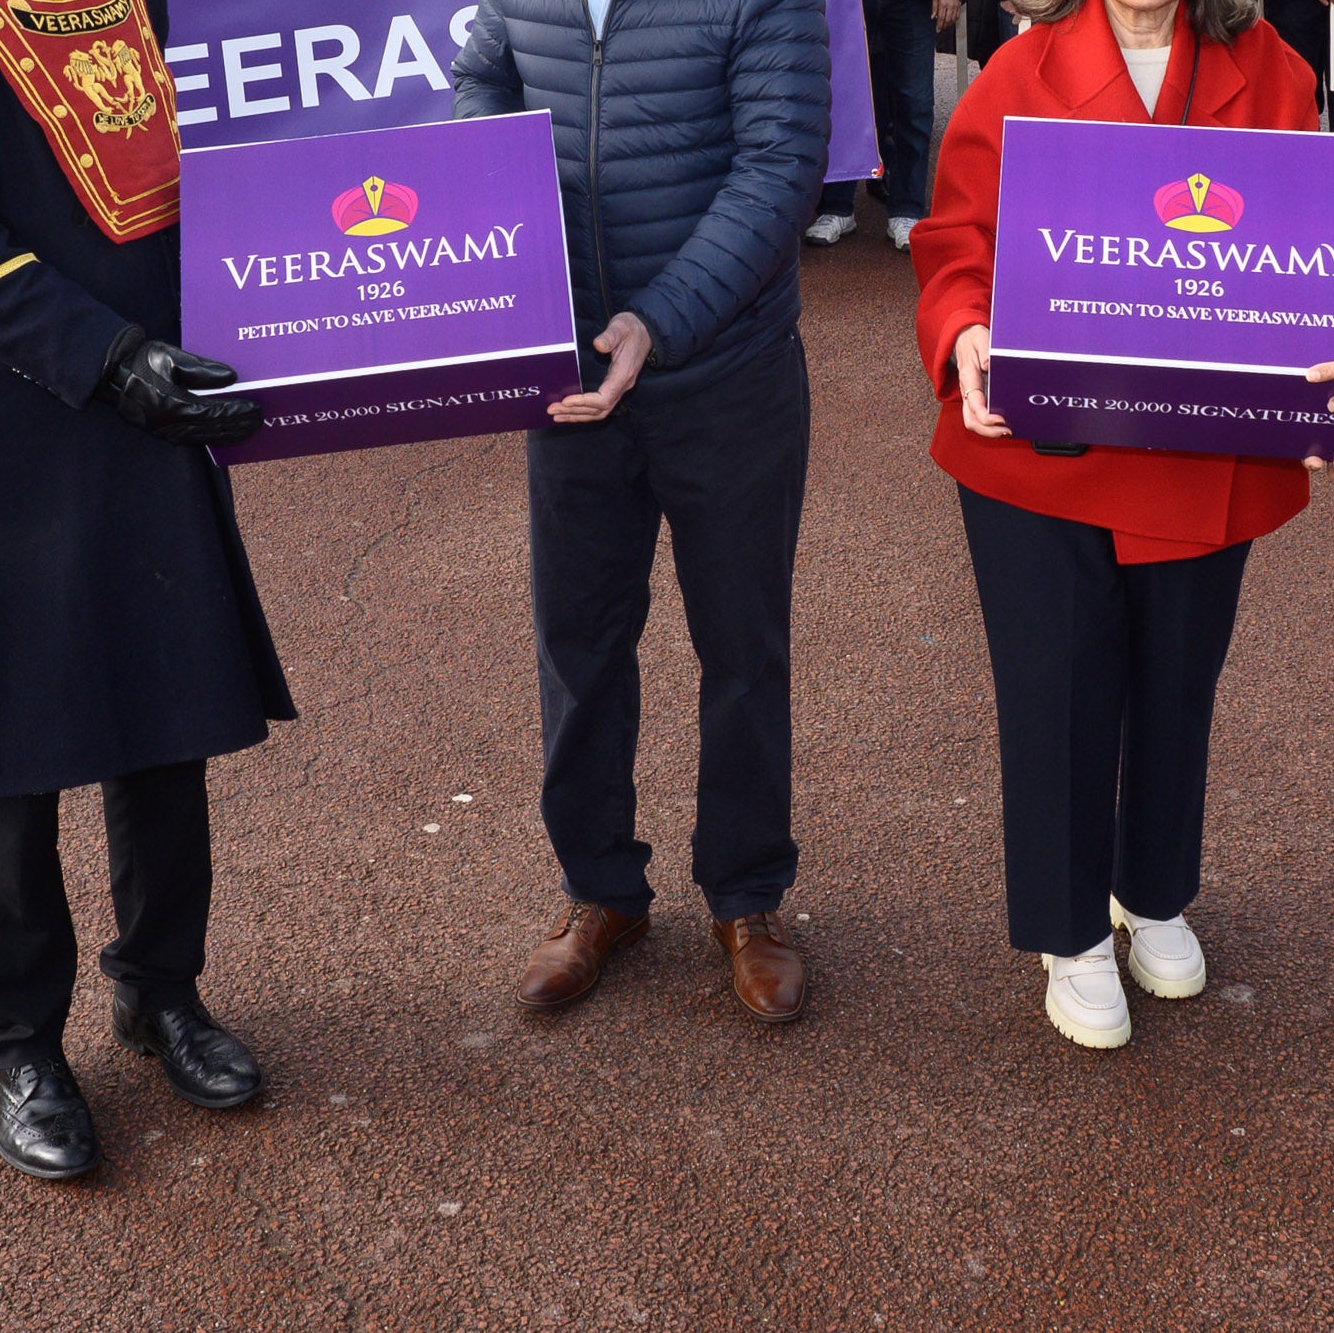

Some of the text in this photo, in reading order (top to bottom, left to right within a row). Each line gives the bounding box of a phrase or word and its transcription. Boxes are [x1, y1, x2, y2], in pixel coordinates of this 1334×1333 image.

[221, 223, 523, 290] VEERASWAMY
[357, 281, 405, 300] 1926
[1175, 279, 1224, 297] 1926
[238, 295, 516, 340] PETITION TO SAVE VEERASWAMY
[1050, 299, 1133, 315] PETITION
[1136, 304, 1164, 317] TO
[1167, 306, 1212, 320] SAVE
[315, 387, 540, 421] 20,000 SIGNATURES
[1029, 395, 1098, 409] OVER
[1105, 400, 1172, 413] 20,000
